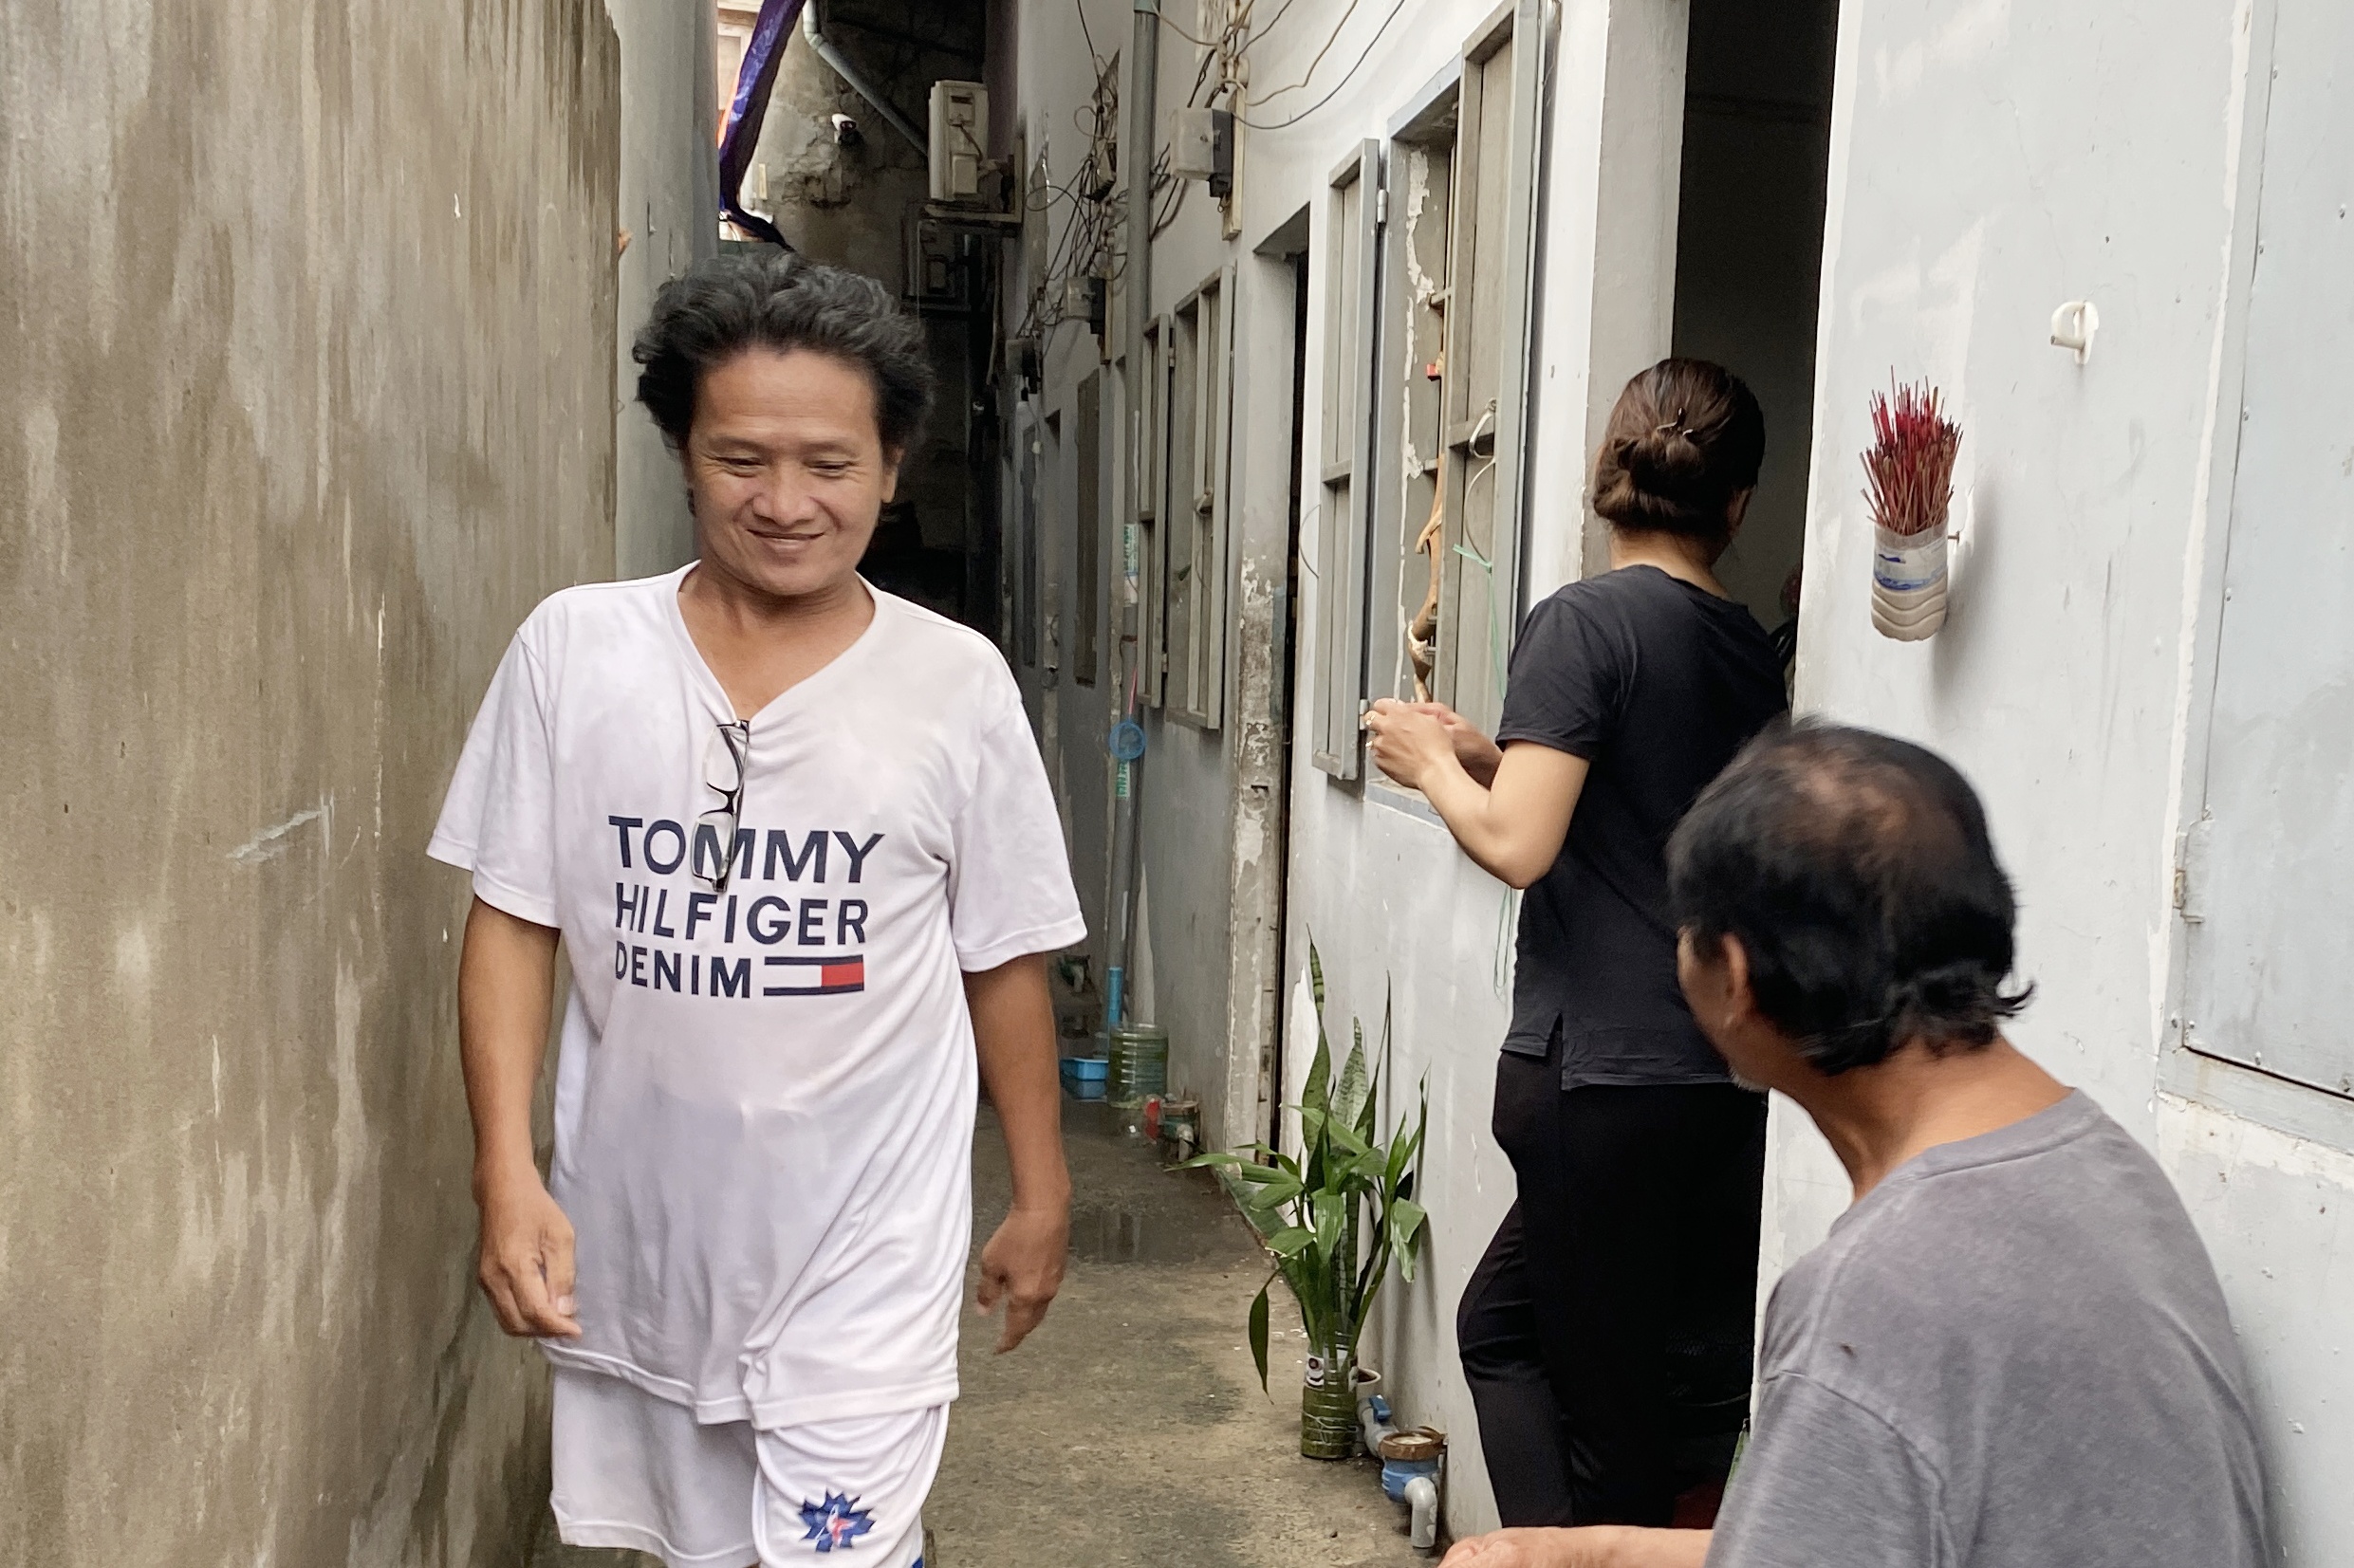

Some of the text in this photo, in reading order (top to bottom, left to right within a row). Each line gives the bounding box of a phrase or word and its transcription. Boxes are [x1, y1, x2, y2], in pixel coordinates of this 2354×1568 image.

[608, 816, 885, 883] TOMMY
[615, 882, 869, 946] HILFIGER
[615, 940, 751, 999] DENIM
